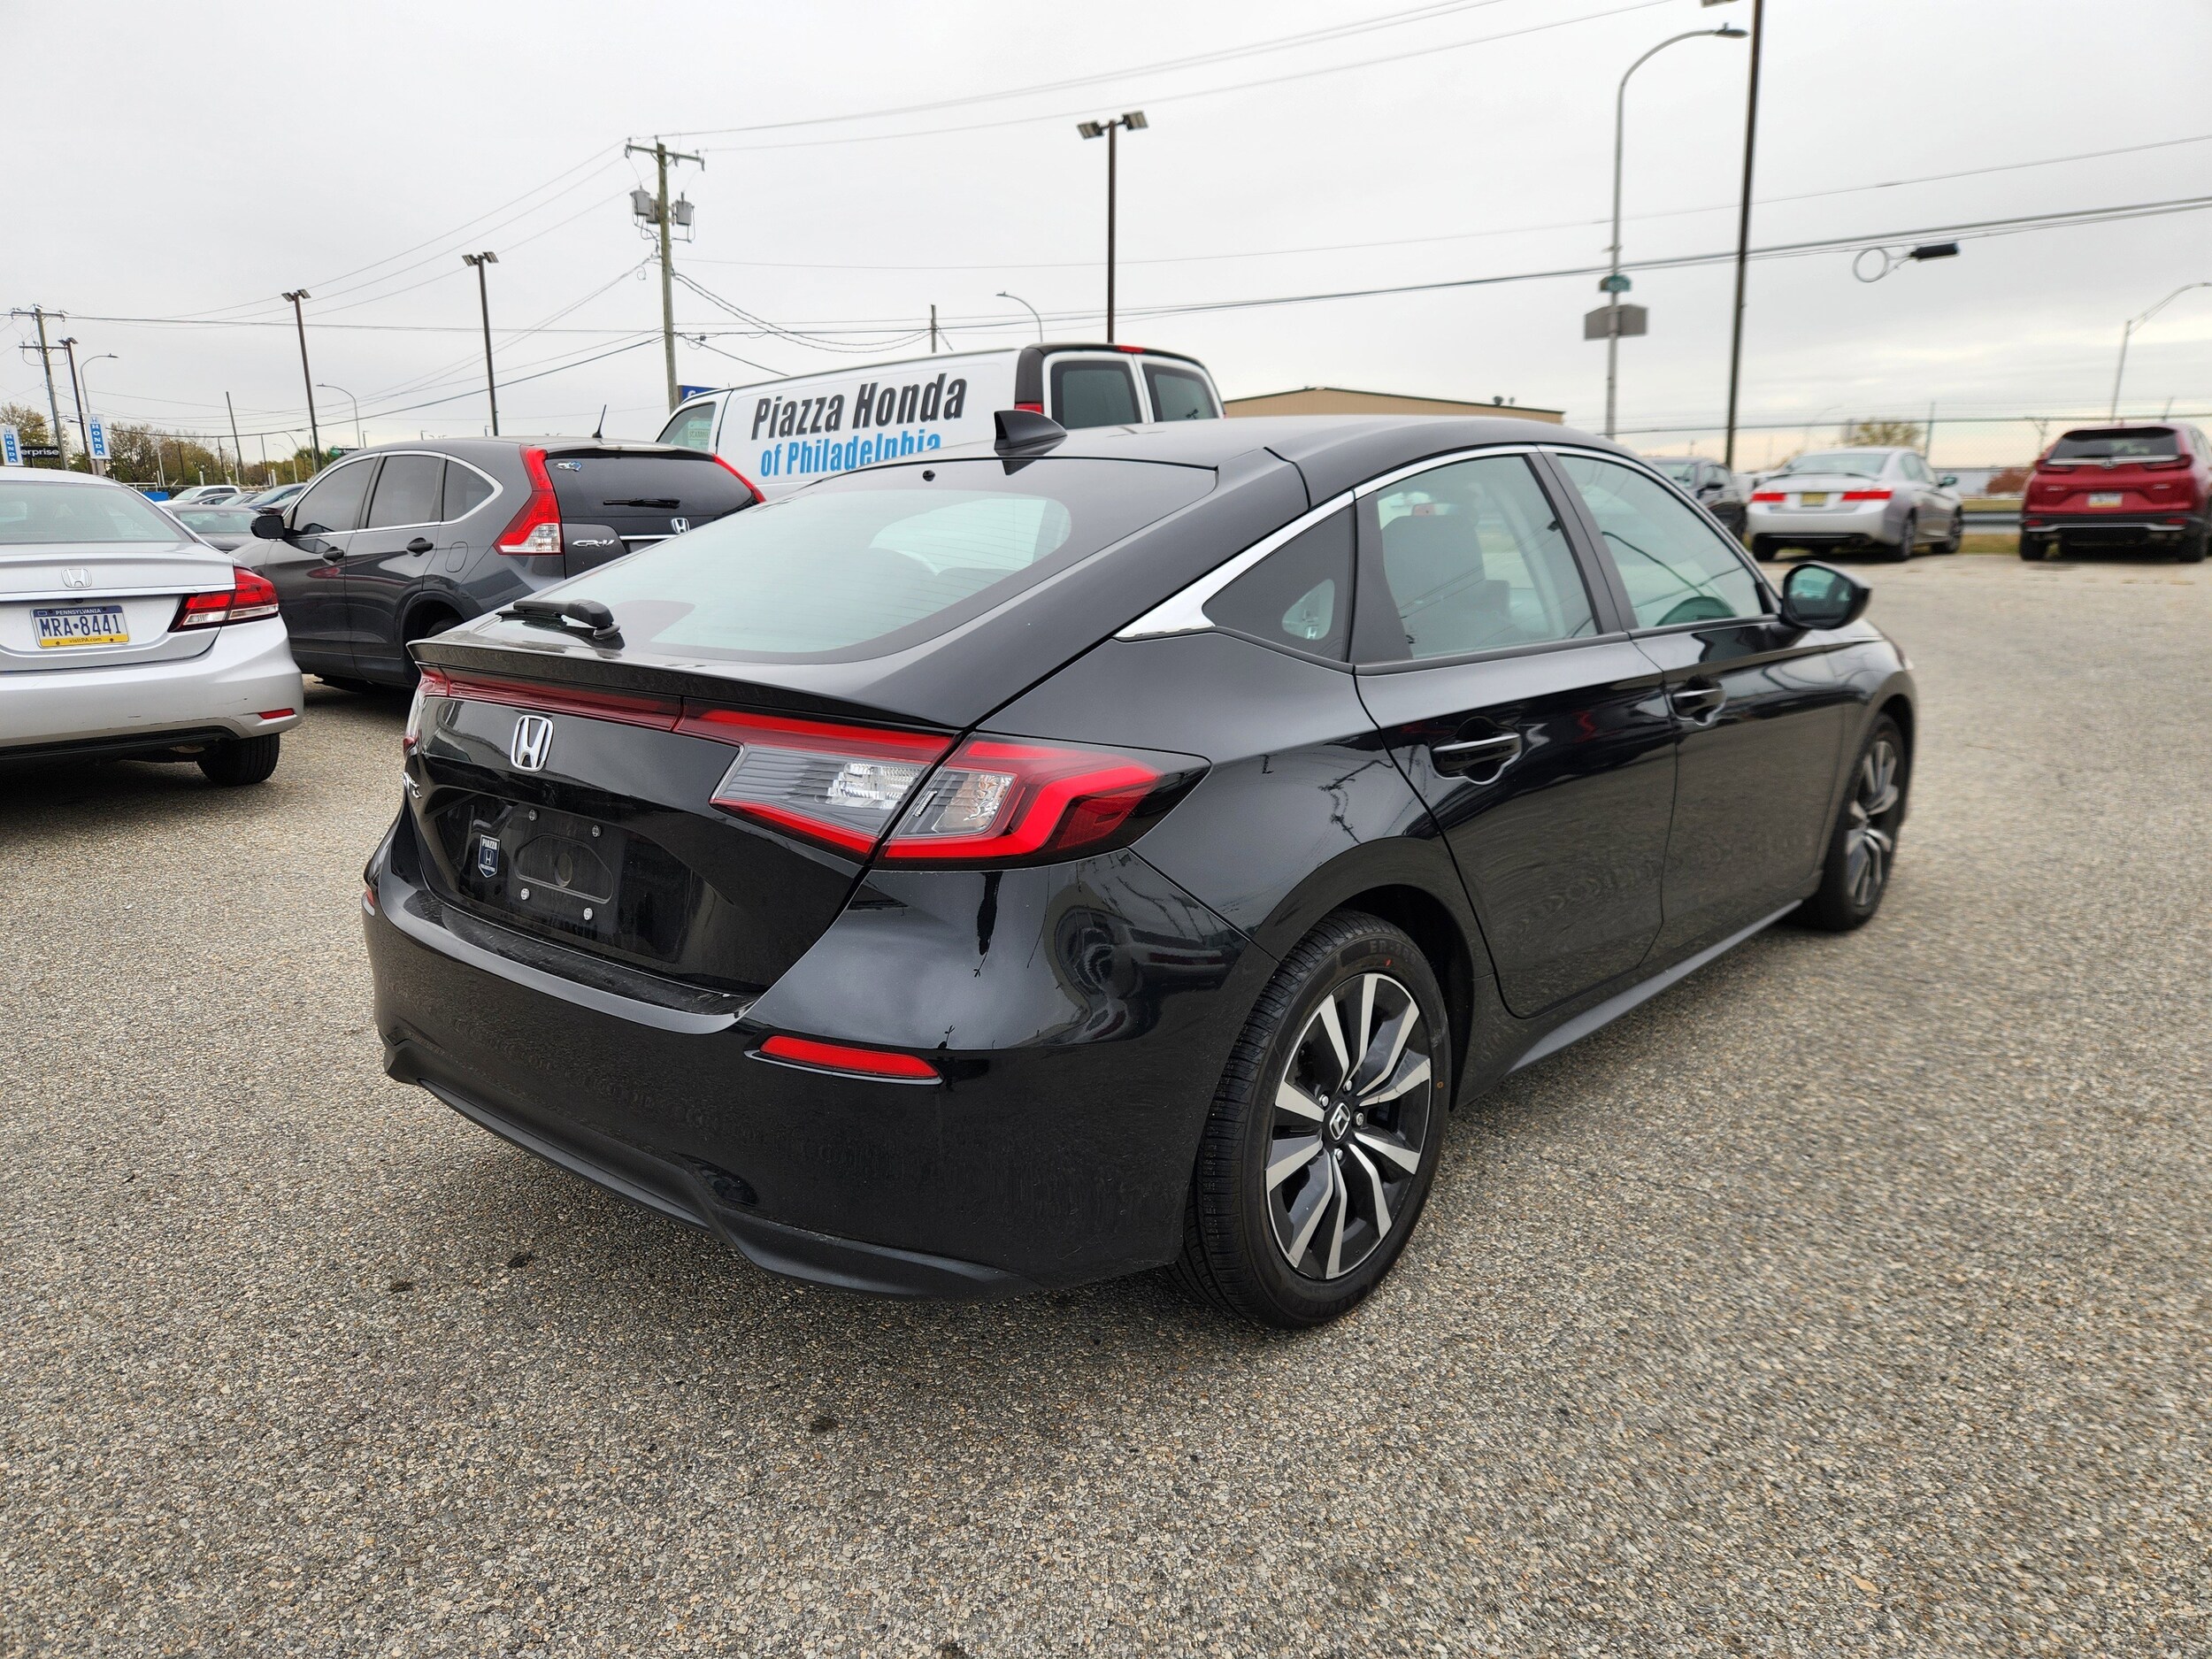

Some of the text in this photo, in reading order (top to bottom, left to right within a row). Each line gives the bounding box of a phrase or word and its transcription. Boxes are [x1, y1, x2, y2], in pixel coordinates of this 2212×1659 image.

[751, 373, 968, 441] Piazza Honda
[5, 434, 17, 462] HONDA
[20, 448, 59, 457] erprise
[92, 424, 104, 455] HONDA
[761, 443, 782, 477] of
